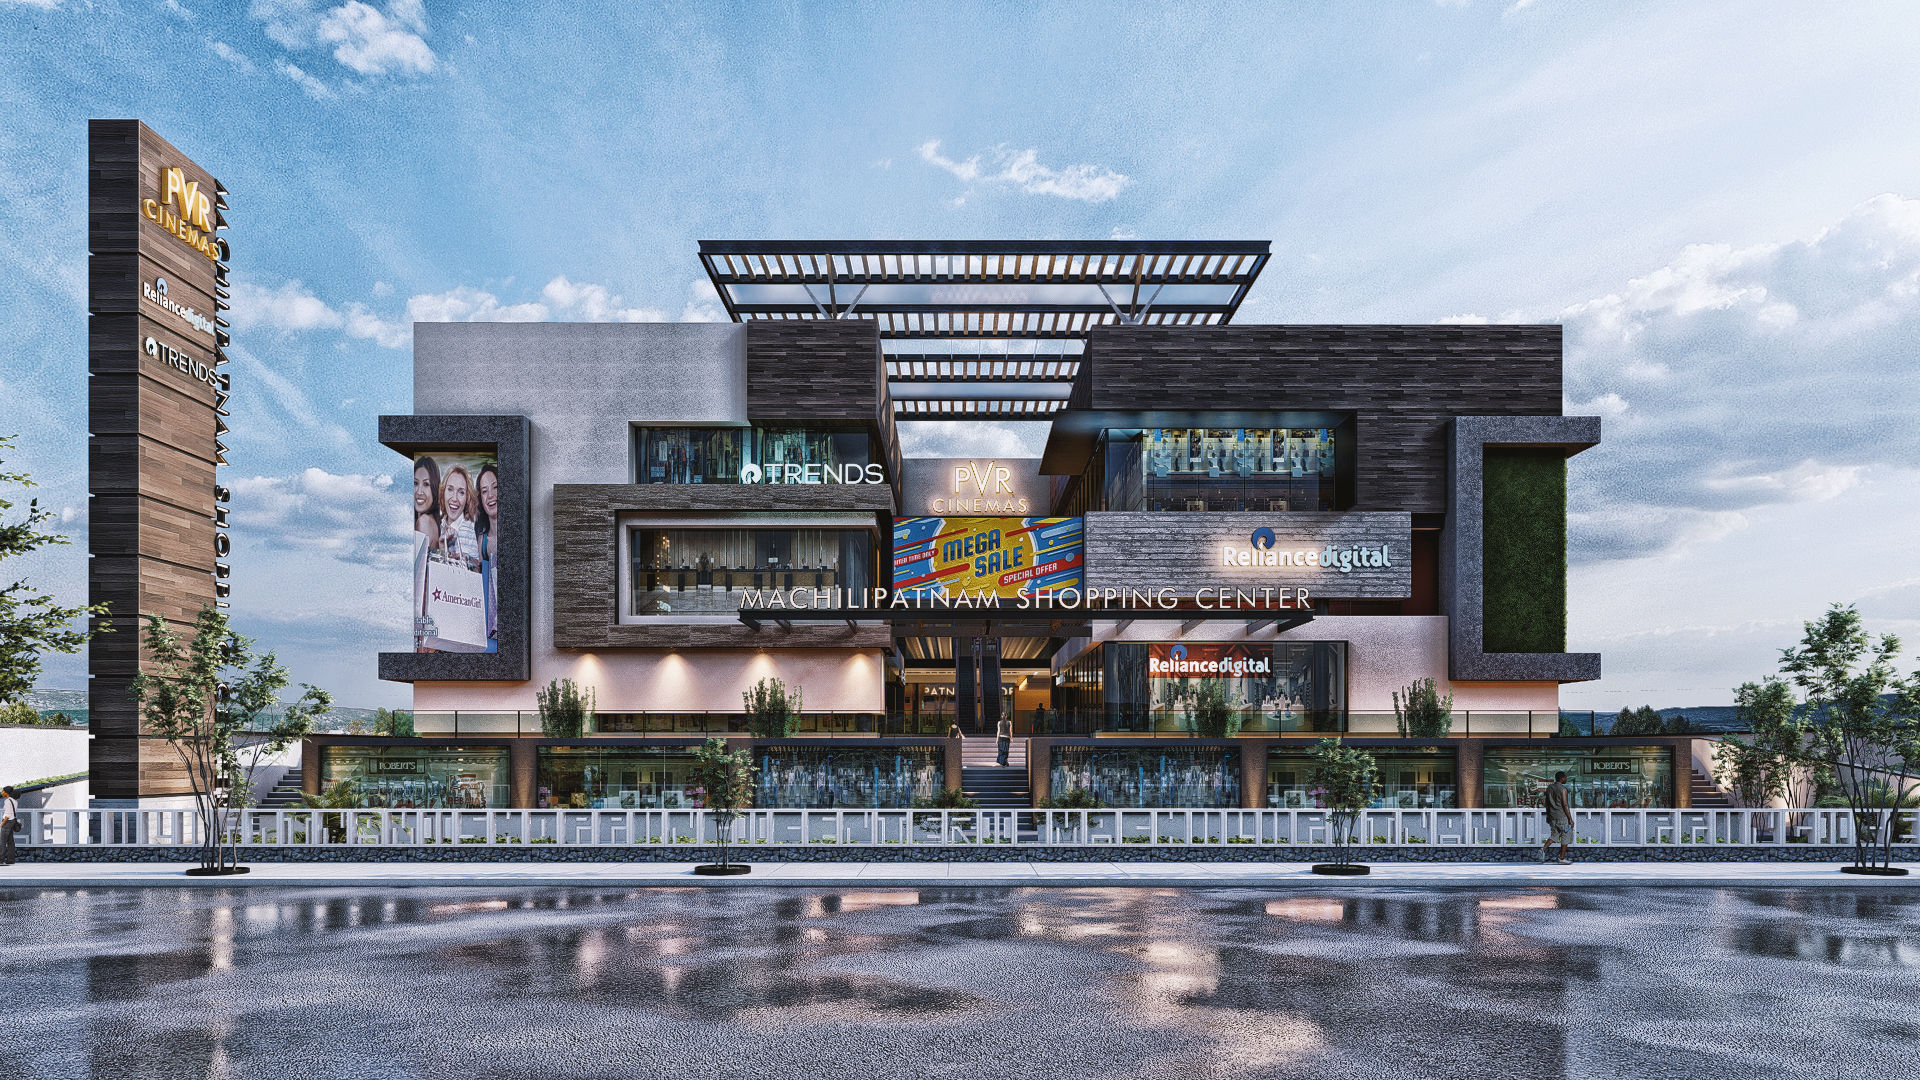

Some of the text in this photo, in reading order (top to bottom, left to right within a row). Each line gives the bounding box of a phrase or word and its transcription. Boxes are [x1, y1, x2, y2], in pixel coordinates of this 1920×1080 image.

[161, 167, 212, 233] PVR
[143, 198, 220, 261] CINEMAS
[143, 281, 216, 337] Reliancedigital
[158, 341, 218, 387] TRENDS
[764, 463, 884, 485] TRENDS
[954, 459, 1014, 495] PVR
[932, 497, 1028, 514] CINEMAS
[943, 529, 1001, 564] MEGA
[1223, 544, 1391, 573] Reliancedigital
[974, 545, 1023, 578] SALE
[1003, 562, 1058, 585] SPECIAL OFFER
[740, 587, 1311, 610] MACHILIPATNAM SHOPPING CENTER
[1149, 656, 1271, 677] Reliancedigital
[379, 761, 416, 770] ROBERT'S
[1593, 761, 1630, 770] ROBERT'S
